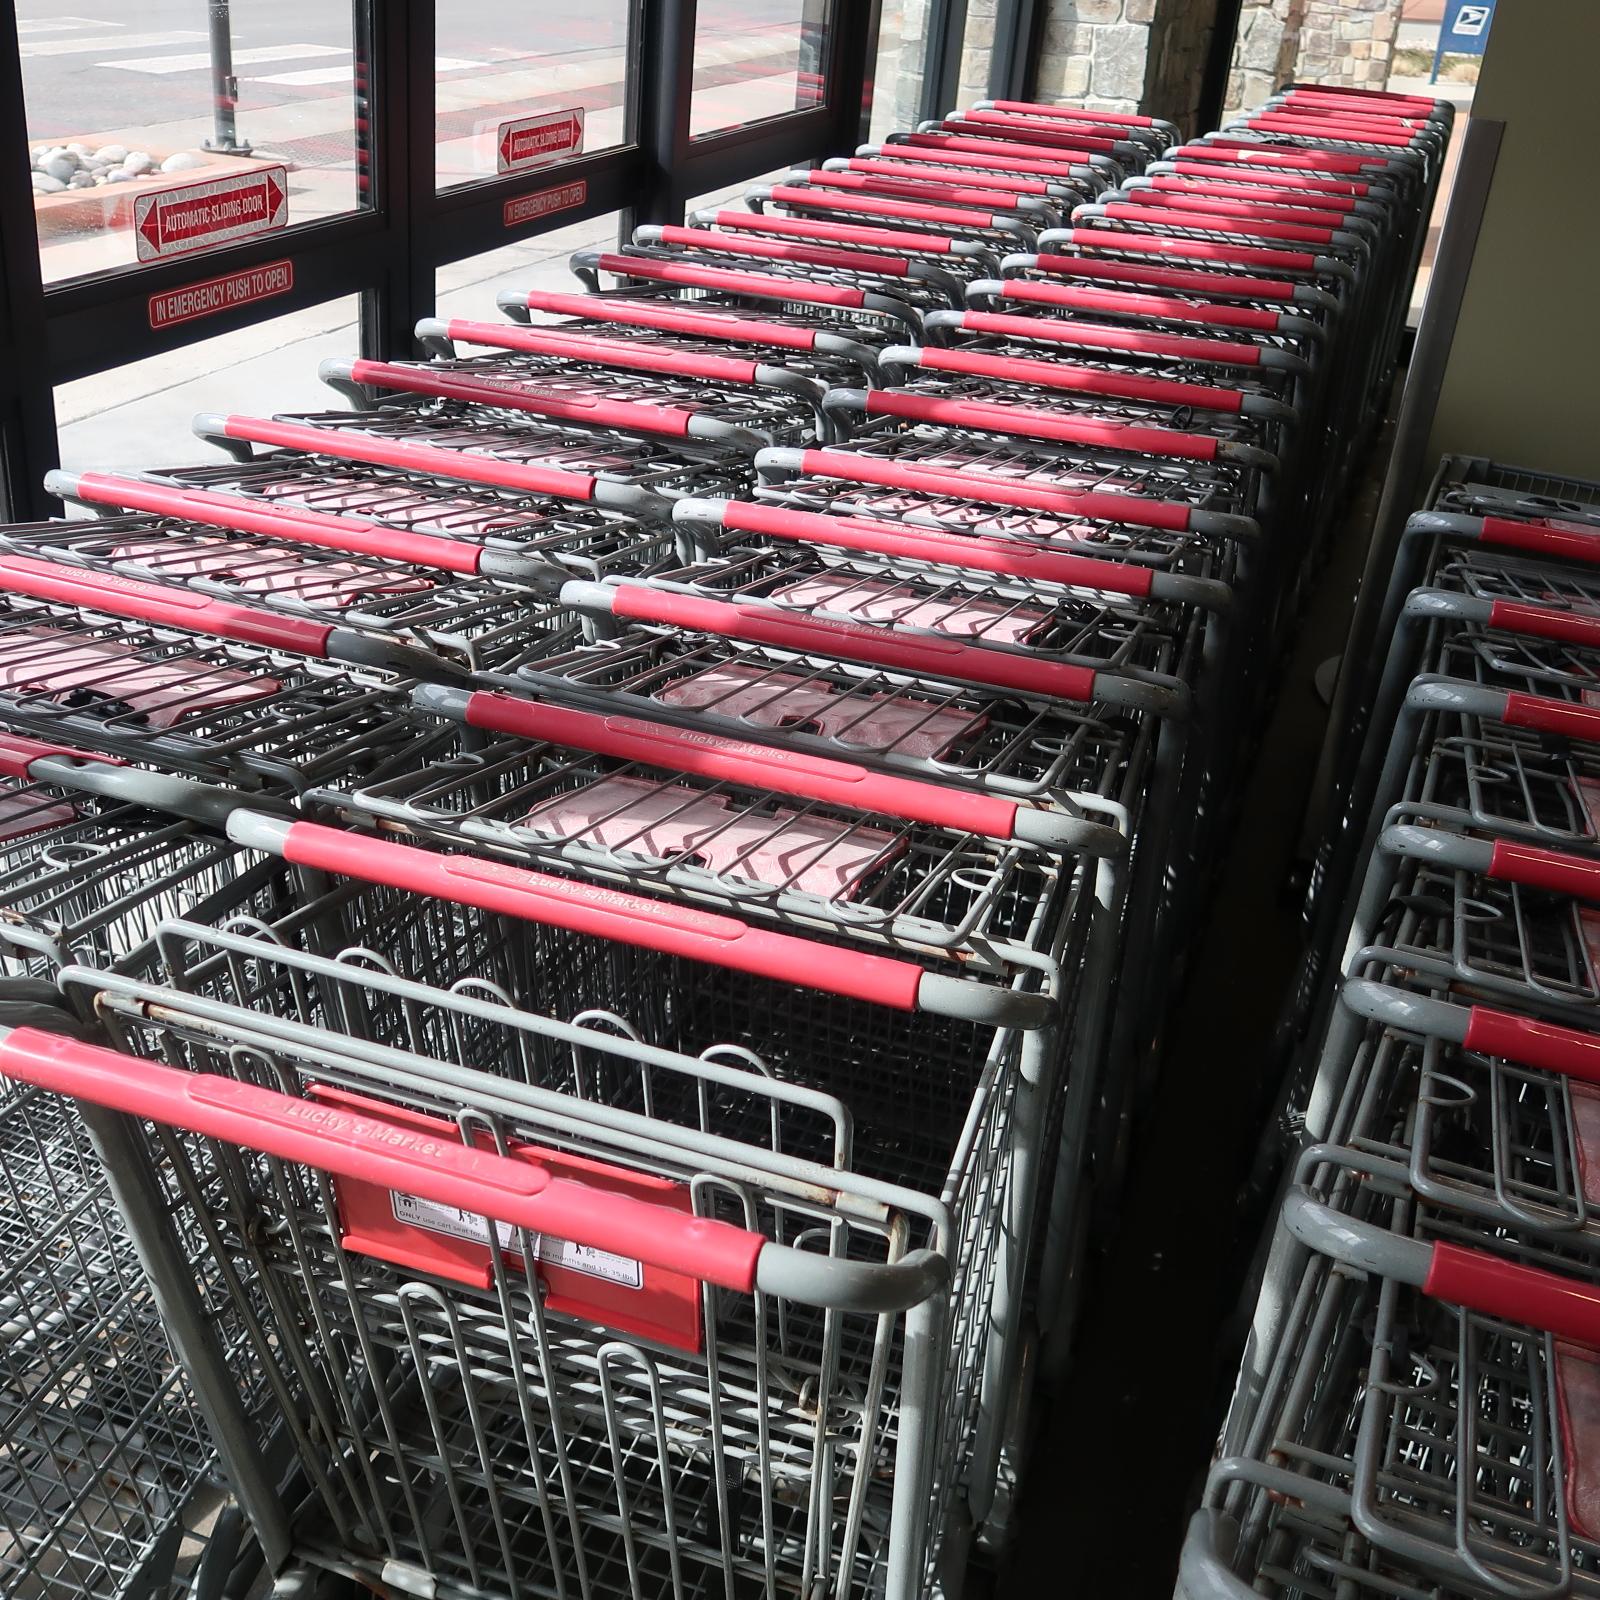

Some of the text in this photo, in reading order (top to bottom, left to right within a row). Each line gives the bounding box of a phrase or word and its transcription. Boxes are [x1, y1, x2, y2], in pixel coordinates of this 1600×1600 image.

[514, 134, 540, 153] AUTOMATIC
[165, 194, 263, 233] AUTOMATIC SLIDING DOOR
[156, 267, 288, 322] IN EMERGENCY PUSH TO OPEN
[285, 1102, 447, 1158] Lucky's Market
[399, 1210, 420, 1220] ONLY
[422, 1217, 436, 1225] use
[437, 1220, 451, 1230] cart
[582, 1262, 597, 1271] and
